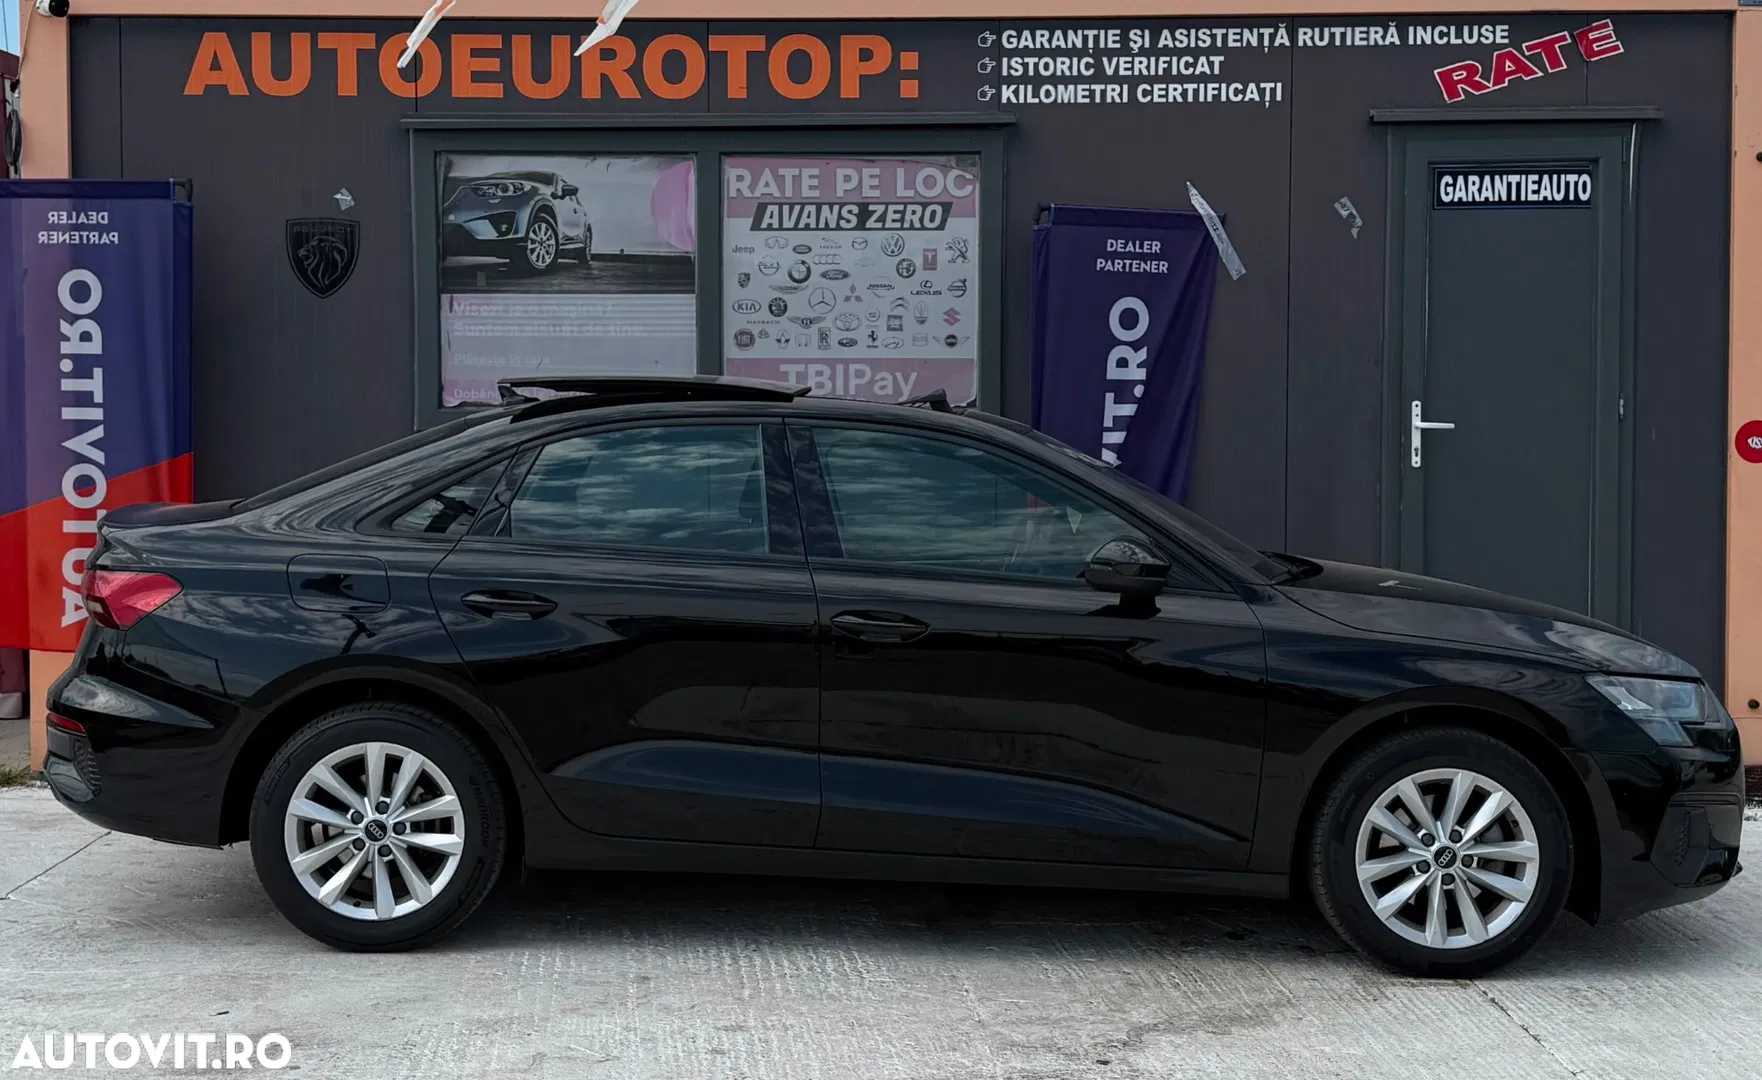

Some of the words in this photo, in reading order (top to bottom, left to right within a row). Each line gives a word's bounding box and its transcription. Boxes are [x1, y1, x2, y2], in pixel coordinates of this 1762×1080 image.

[1298, 22, 1400, 46] RUTIERĂ
[1408, 24, 1509, 45] INCLUSE
[183, 32, 919, 100] AUTOEUROTOP:
[1002, 57, 1095, 76] ISTORIC
[1102, 56, 1225, 76] VERIFICAT
[1434, 19, 1624, 103] RATE
[1001, 84, 1128, 104] KILOMETRI
[1136, 82, 1282, 108] CERTIFICAȚI
[729, 167, 819, 199] RATE
[836, 167, 880, 198] PE
[897, 167, 974, 199] LOC
[1440, 173, 1591, 202] GARANTIEAUTO
[760, 204, 859, 229] AVANS
[865, 204, 944, 229] ZERO
[732, 244, 755, 255] Jeep
[1106, 239, 1161, 254] DEALER
[1096, 258, 1168, 274] PARTENER
[779, 363, 918, 402] TBIPay
